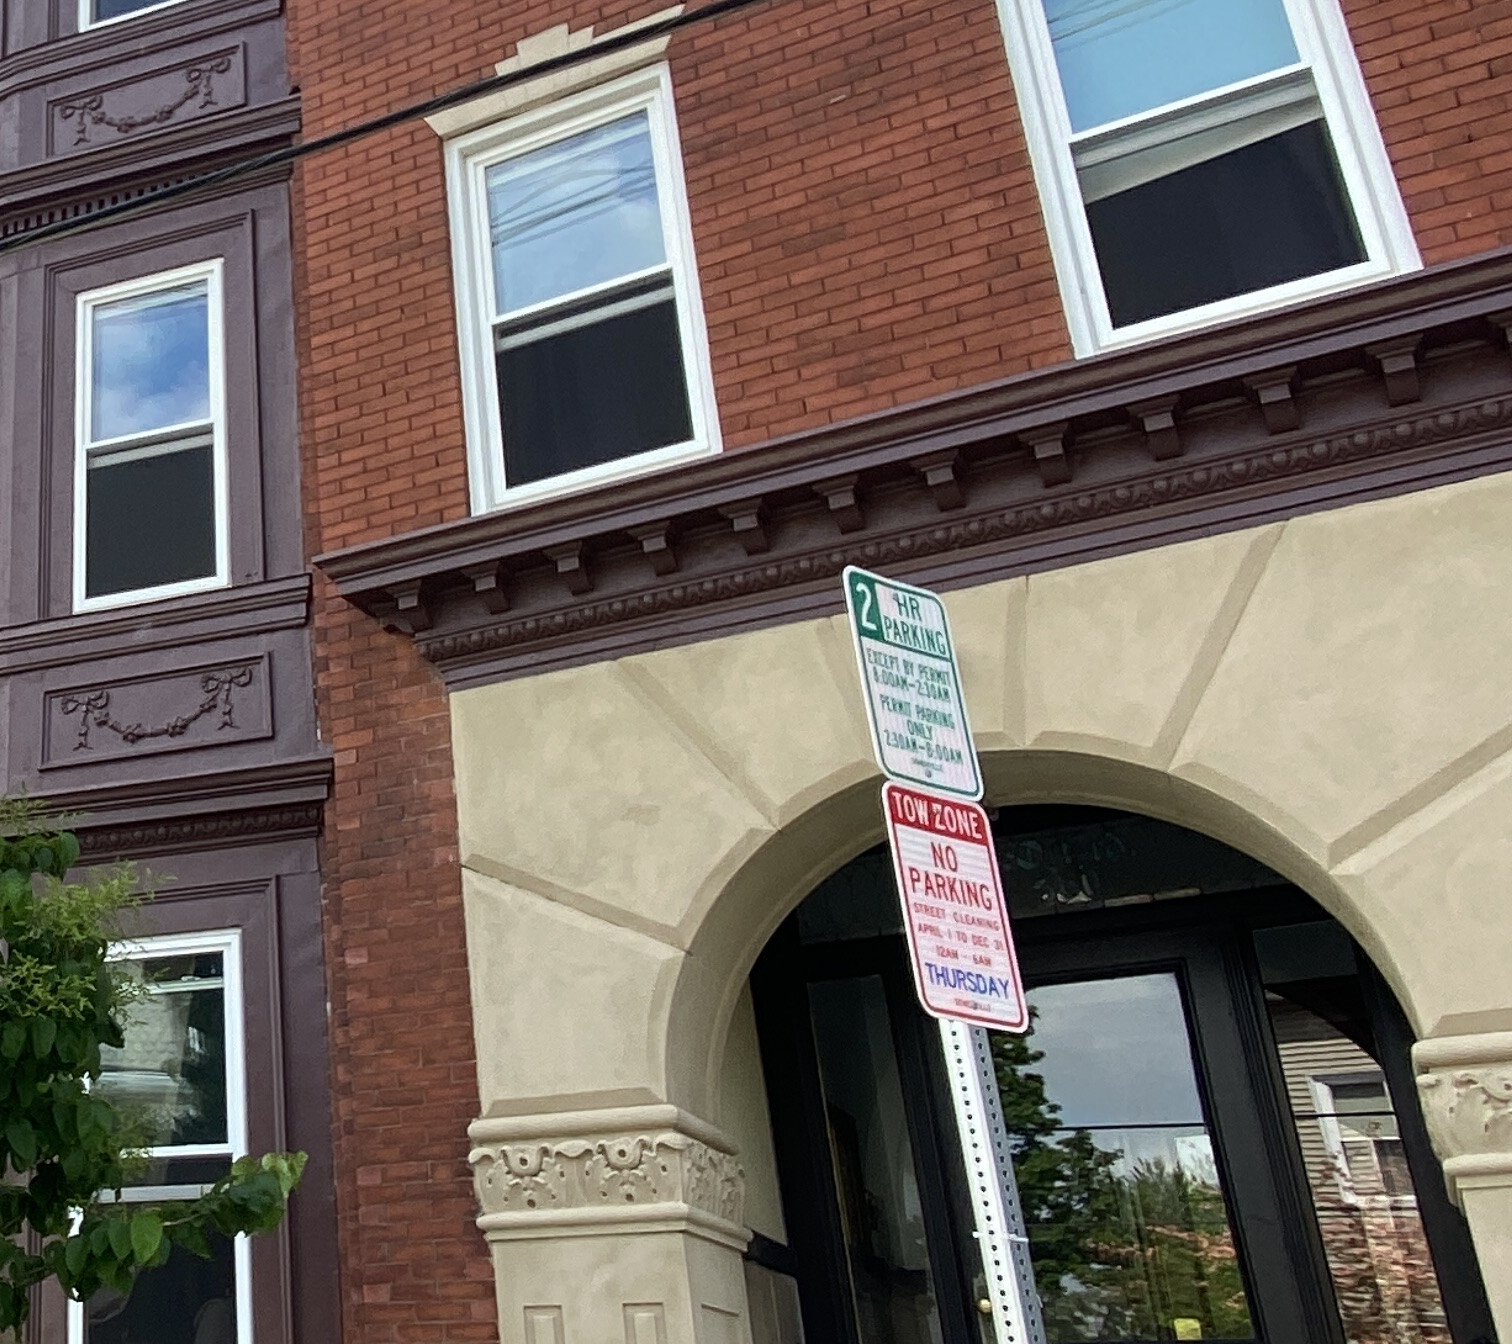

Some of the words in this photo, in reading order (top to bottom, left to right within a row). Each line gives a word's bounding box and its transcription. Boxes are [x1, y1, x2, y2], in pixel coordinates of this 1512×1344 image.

[856, 582, 877, 631] 2
[894, 593, 922, 622] HR
[884, 616, 946, 655] PARKING
[867, 648, 899, 672] EXCEPT
[903, 659, 914, 676] BY
[919, 664, 950, 687] PERMIT
[880, 694, 911, 716] PERMIT
[915, 704, 955, 729] PARKING
[907, 719, 932, 741] ONLY
[892, 792, 929, 827] TOW
[933, 804, 983, 839] ZONE
[931, 841, 958, 872] NO
[909, 867, 992, 911] PARKING
[914, 902, 945, 919] STREET
[953, 911, 999, 931] CLEANING
[919, 923, 943, 938] APRIL
[956, 930, 968, 943] TO
[972, 934, 989, 948] DEC
[936, 945, 958, 959] 12AM
[925, 962, 1009, 999] THURSDAY
